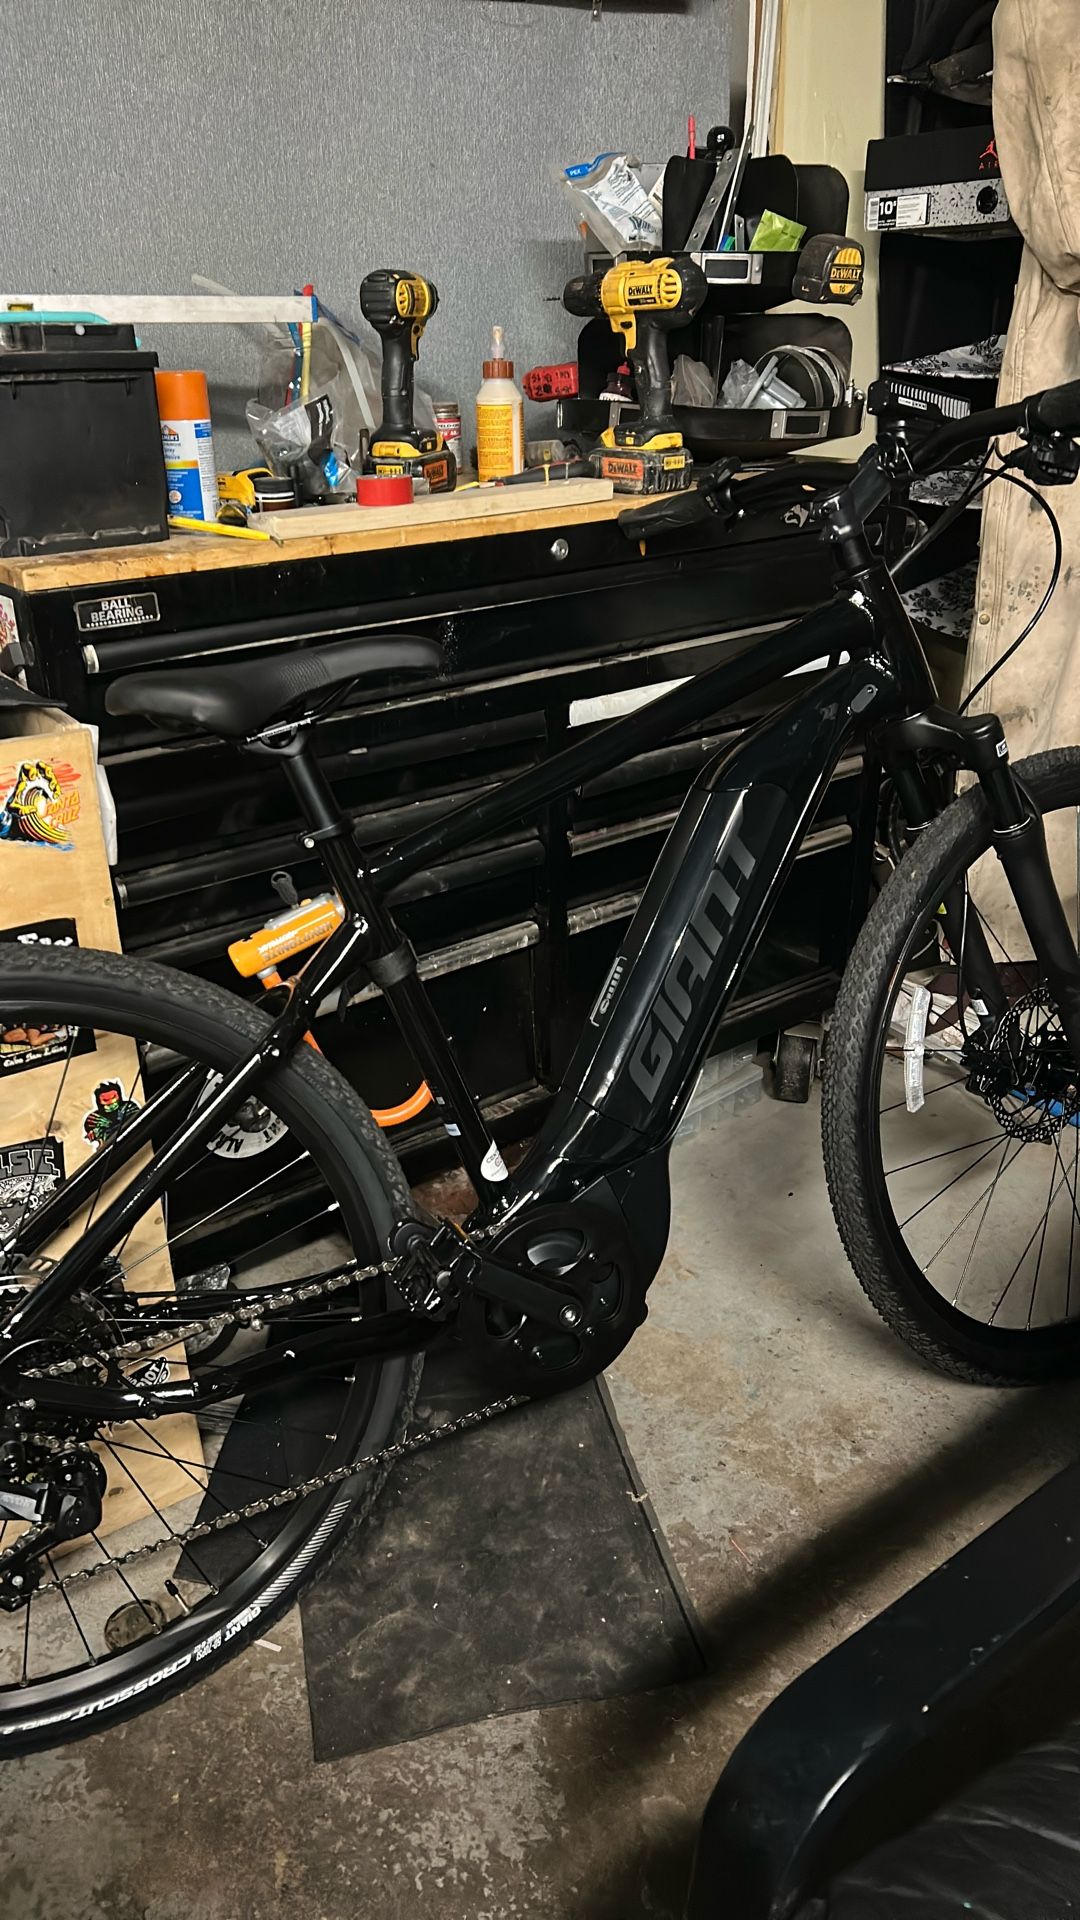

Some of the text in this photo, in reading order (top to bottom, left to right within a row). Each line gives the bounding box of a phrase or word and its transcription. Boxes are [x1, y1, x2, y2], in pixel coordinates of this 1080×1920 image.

[90, 605, 145, 623] BEARING
[100, 597, 132, 611] BALL
[628, 832, 757, 1105] GIANT
[224, 1605, 262, 1642] GIANT
[70, 1652, 192, 1722] CROSSCUT
